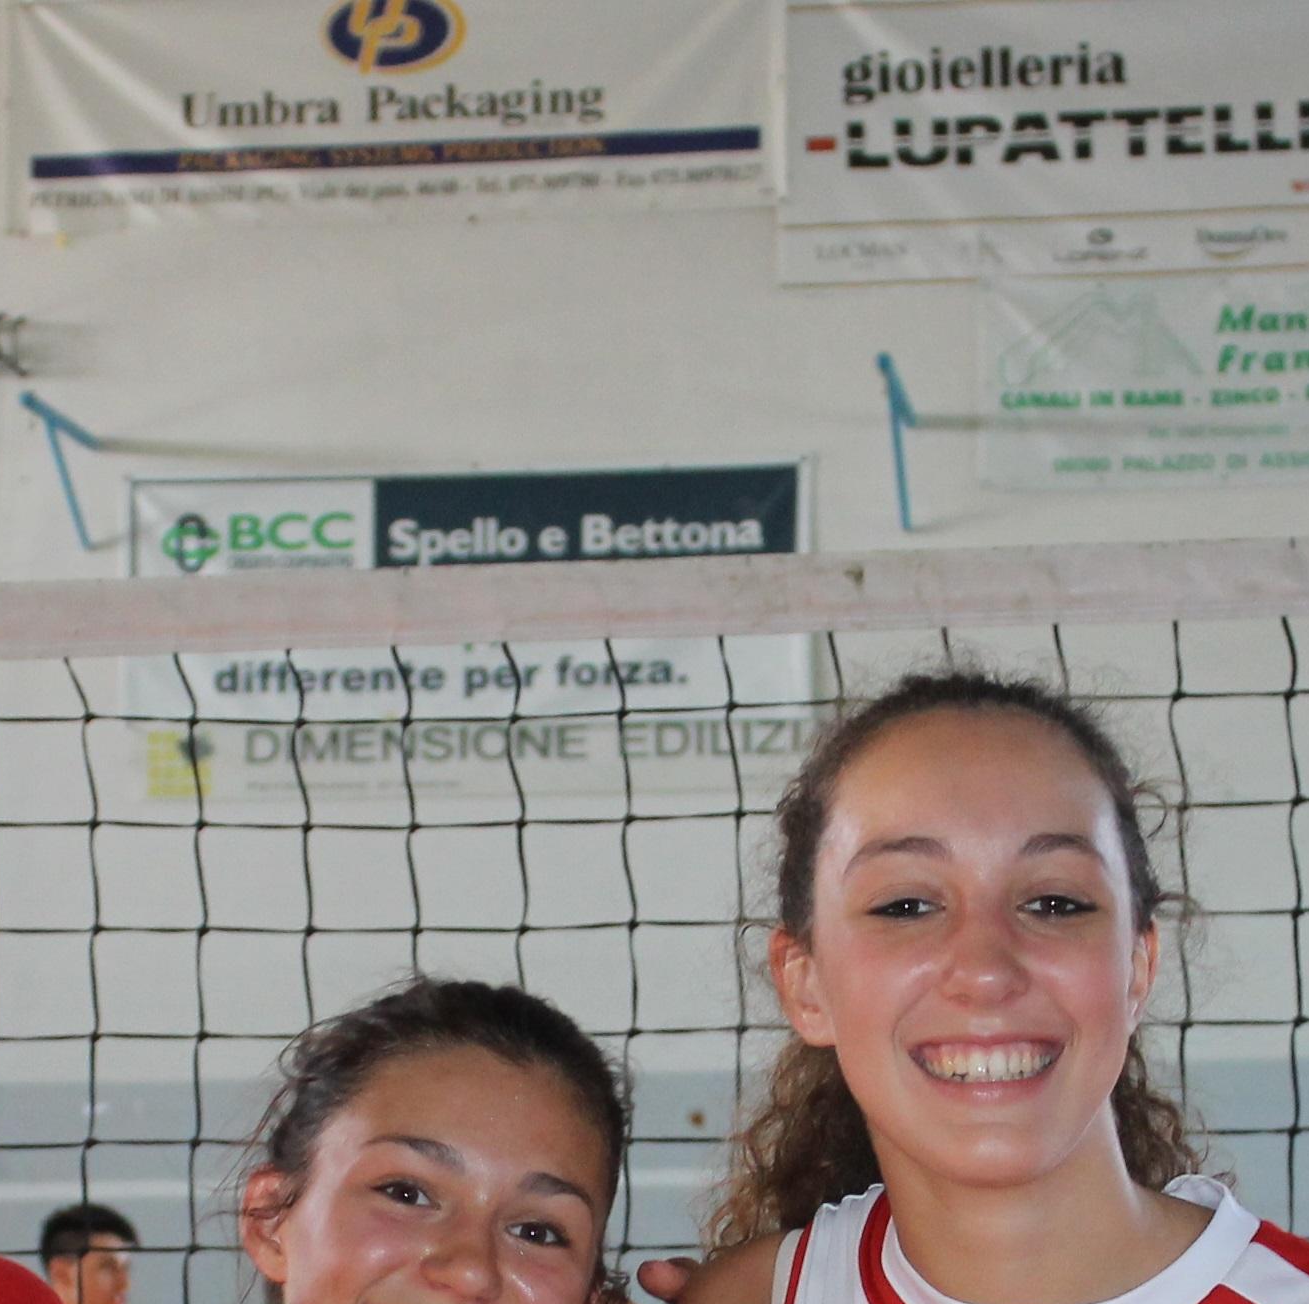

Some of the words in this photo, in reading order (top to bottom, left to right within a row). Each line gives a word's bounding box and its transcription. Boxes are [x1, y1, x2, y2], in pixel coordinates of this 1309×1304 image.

[842, 45, 1128, 104] gioielleria
[181, 90, 342, 130] Umbra
[366, 80, 606, 127] Packaging
[228, 511, 356, 552] BCC
[387, 516, 527, 567] Spello
[537, 522, 568, 555] e
[580, 512, 765, 554] Bettona
[214, 661, 448, 697] differente
[463, 659, 544, 698] per
[557, 653, 690, 688] forza.
[243, 720, 589, 767] DIMENSIONE
[618, 716, 818, 762] EDILIZI
